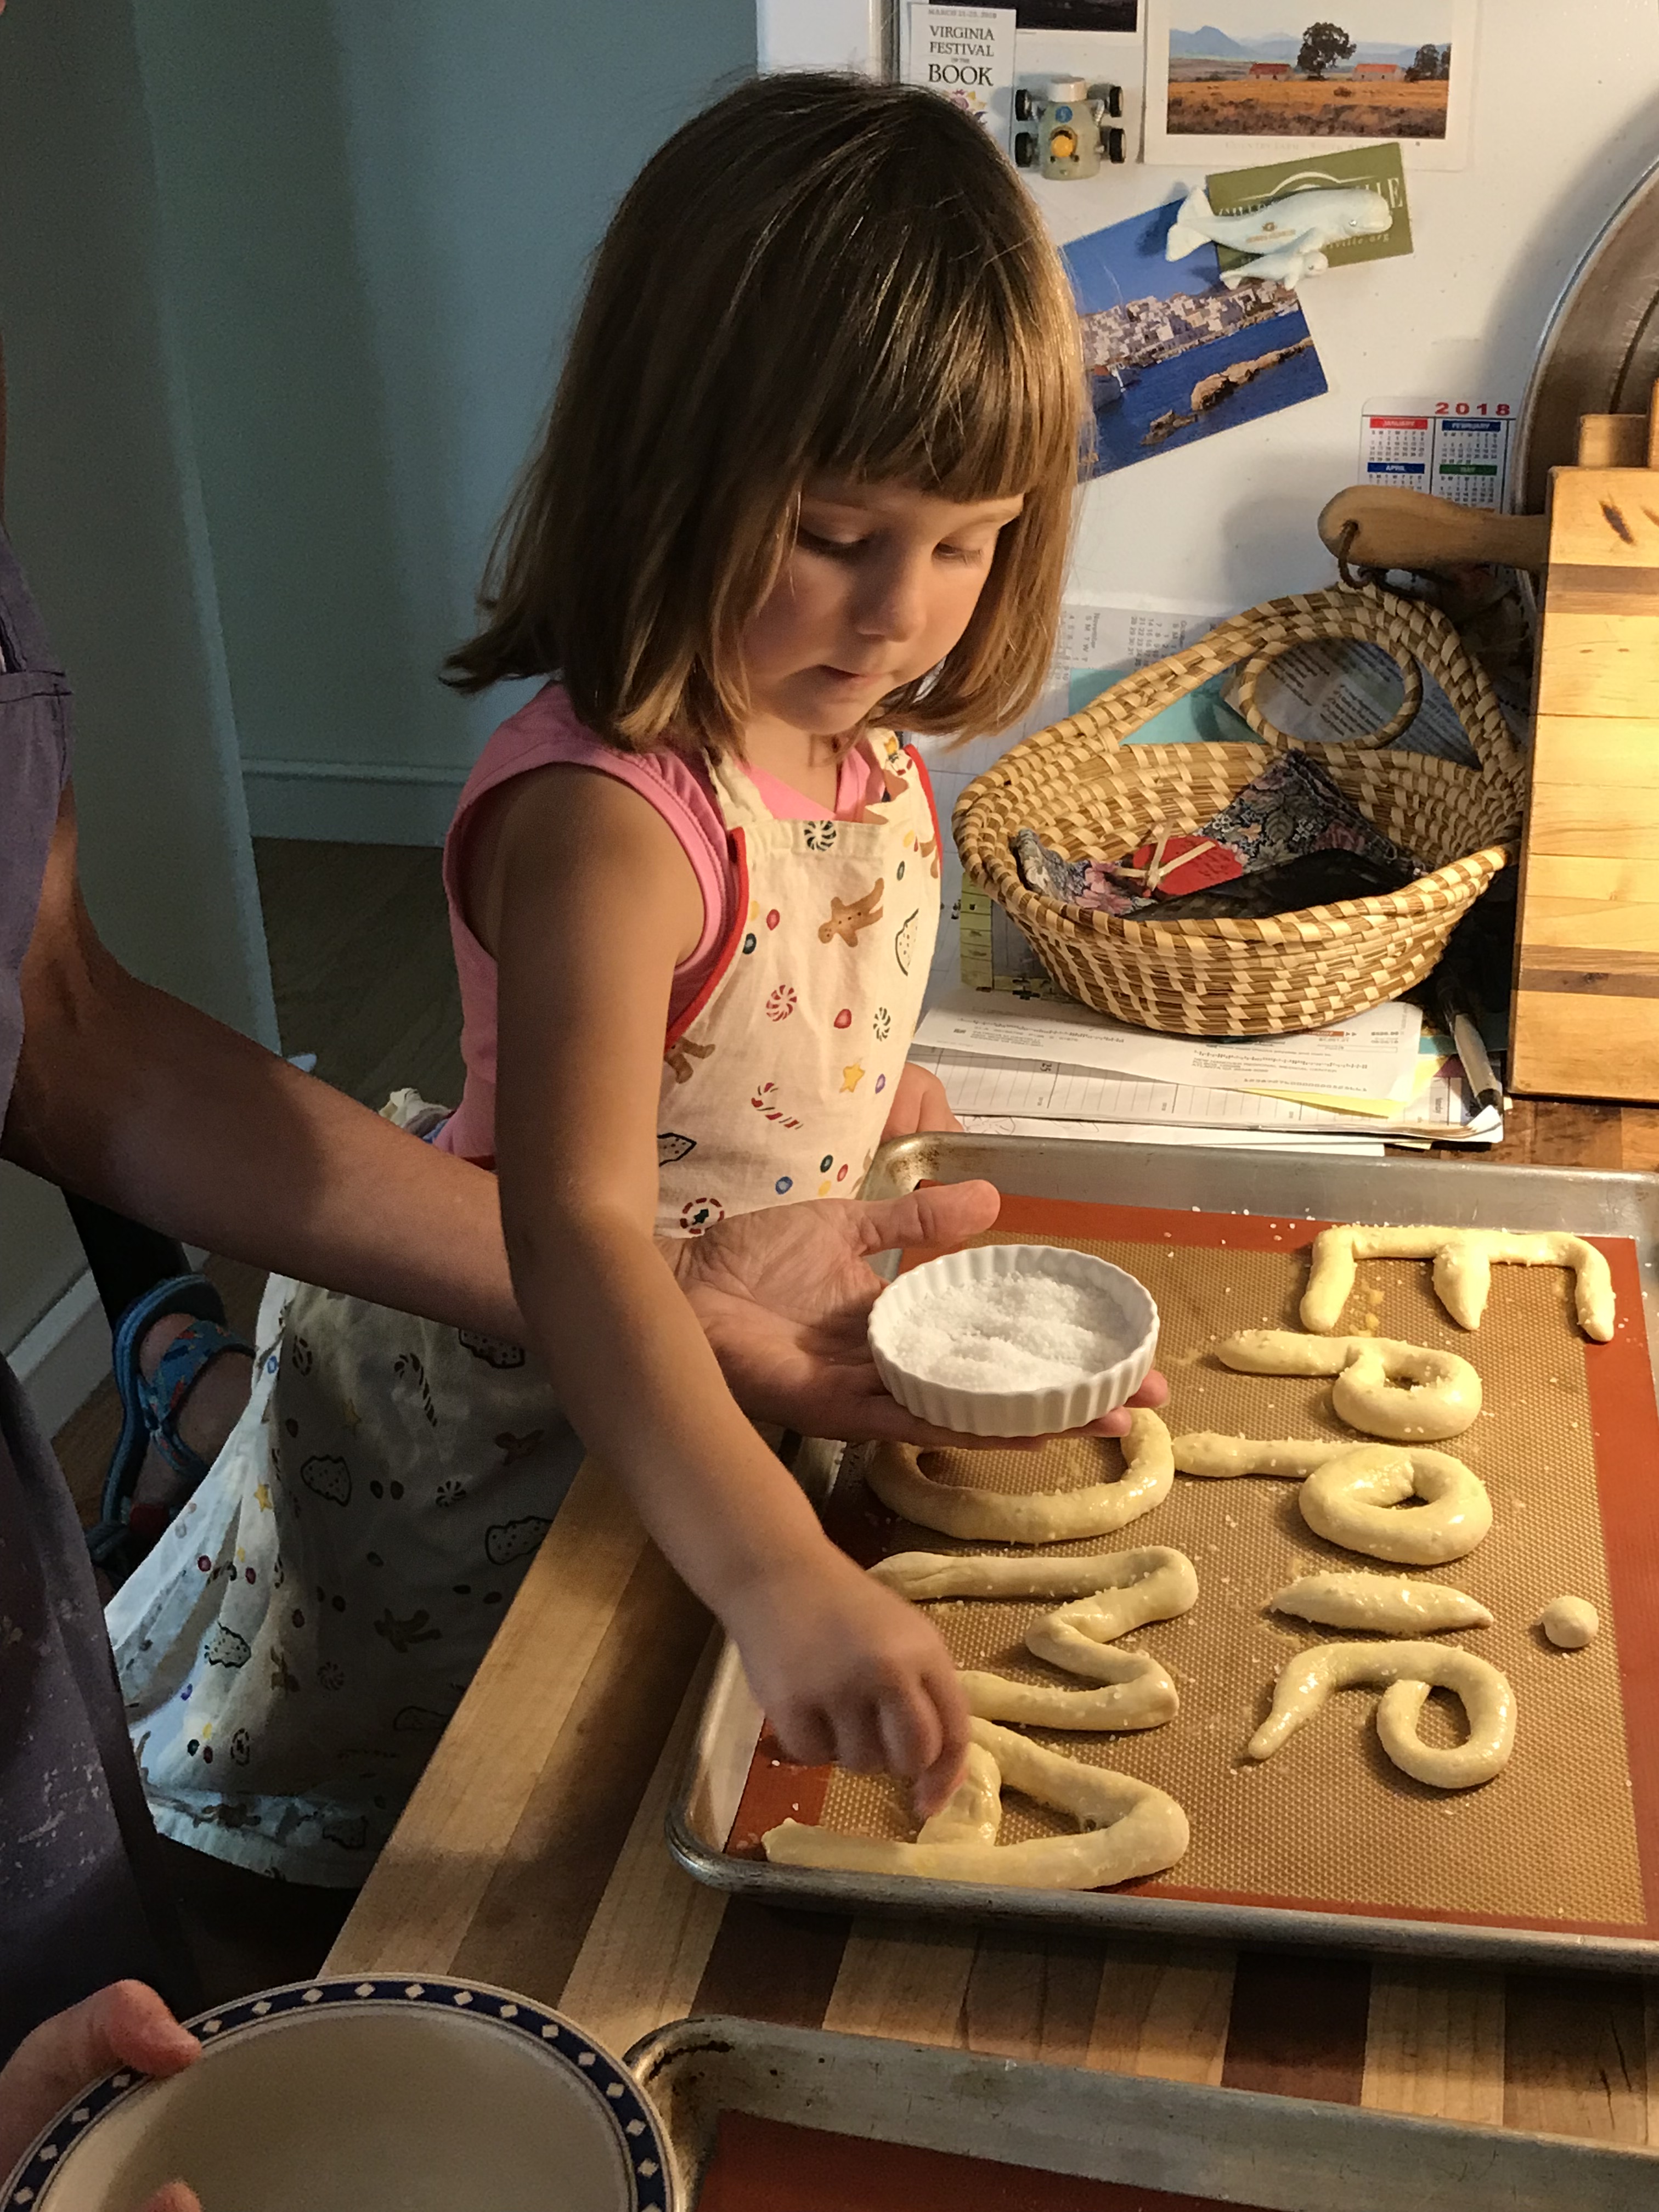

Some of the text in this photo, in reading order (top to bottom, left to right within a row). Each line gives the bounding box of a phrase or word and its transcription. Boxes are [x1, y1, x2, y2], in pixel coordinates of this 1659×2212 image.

[929, 25, 995, 41] VIRGINIA
[930, 41, 994, 57] FESTIVAL
[928, 63, 994, 86] BOOK
[1435, 402, 1510, 416] 2018
